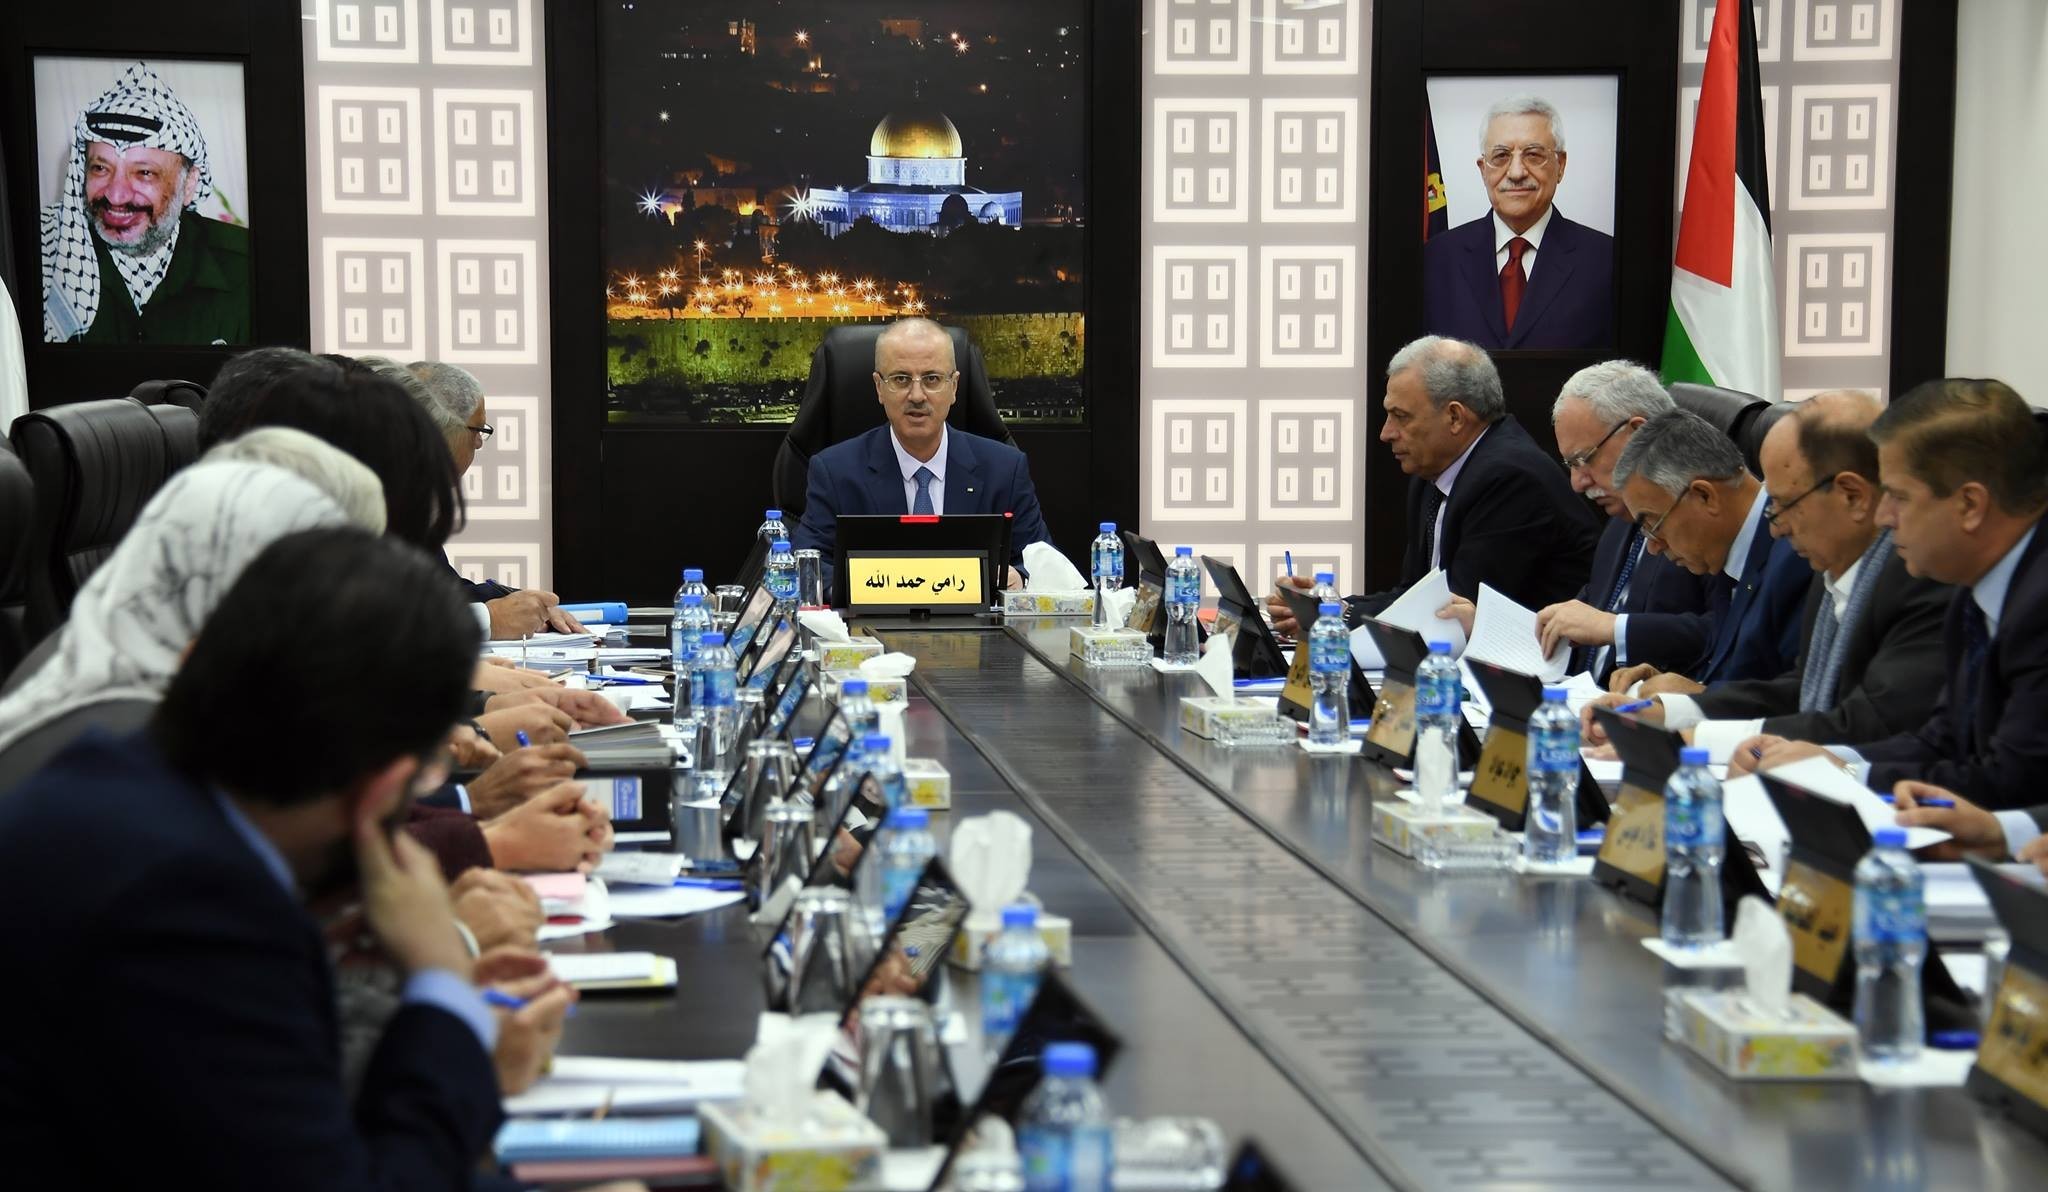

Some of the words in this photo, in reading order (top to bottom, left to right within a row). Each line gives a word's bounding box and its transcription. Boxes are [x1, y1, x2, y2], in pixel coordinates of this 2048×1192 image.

[865, 569, 890, 588] الله
[896, 575, 926, 588] حمد
[932, 575, 966, 595] رامي
